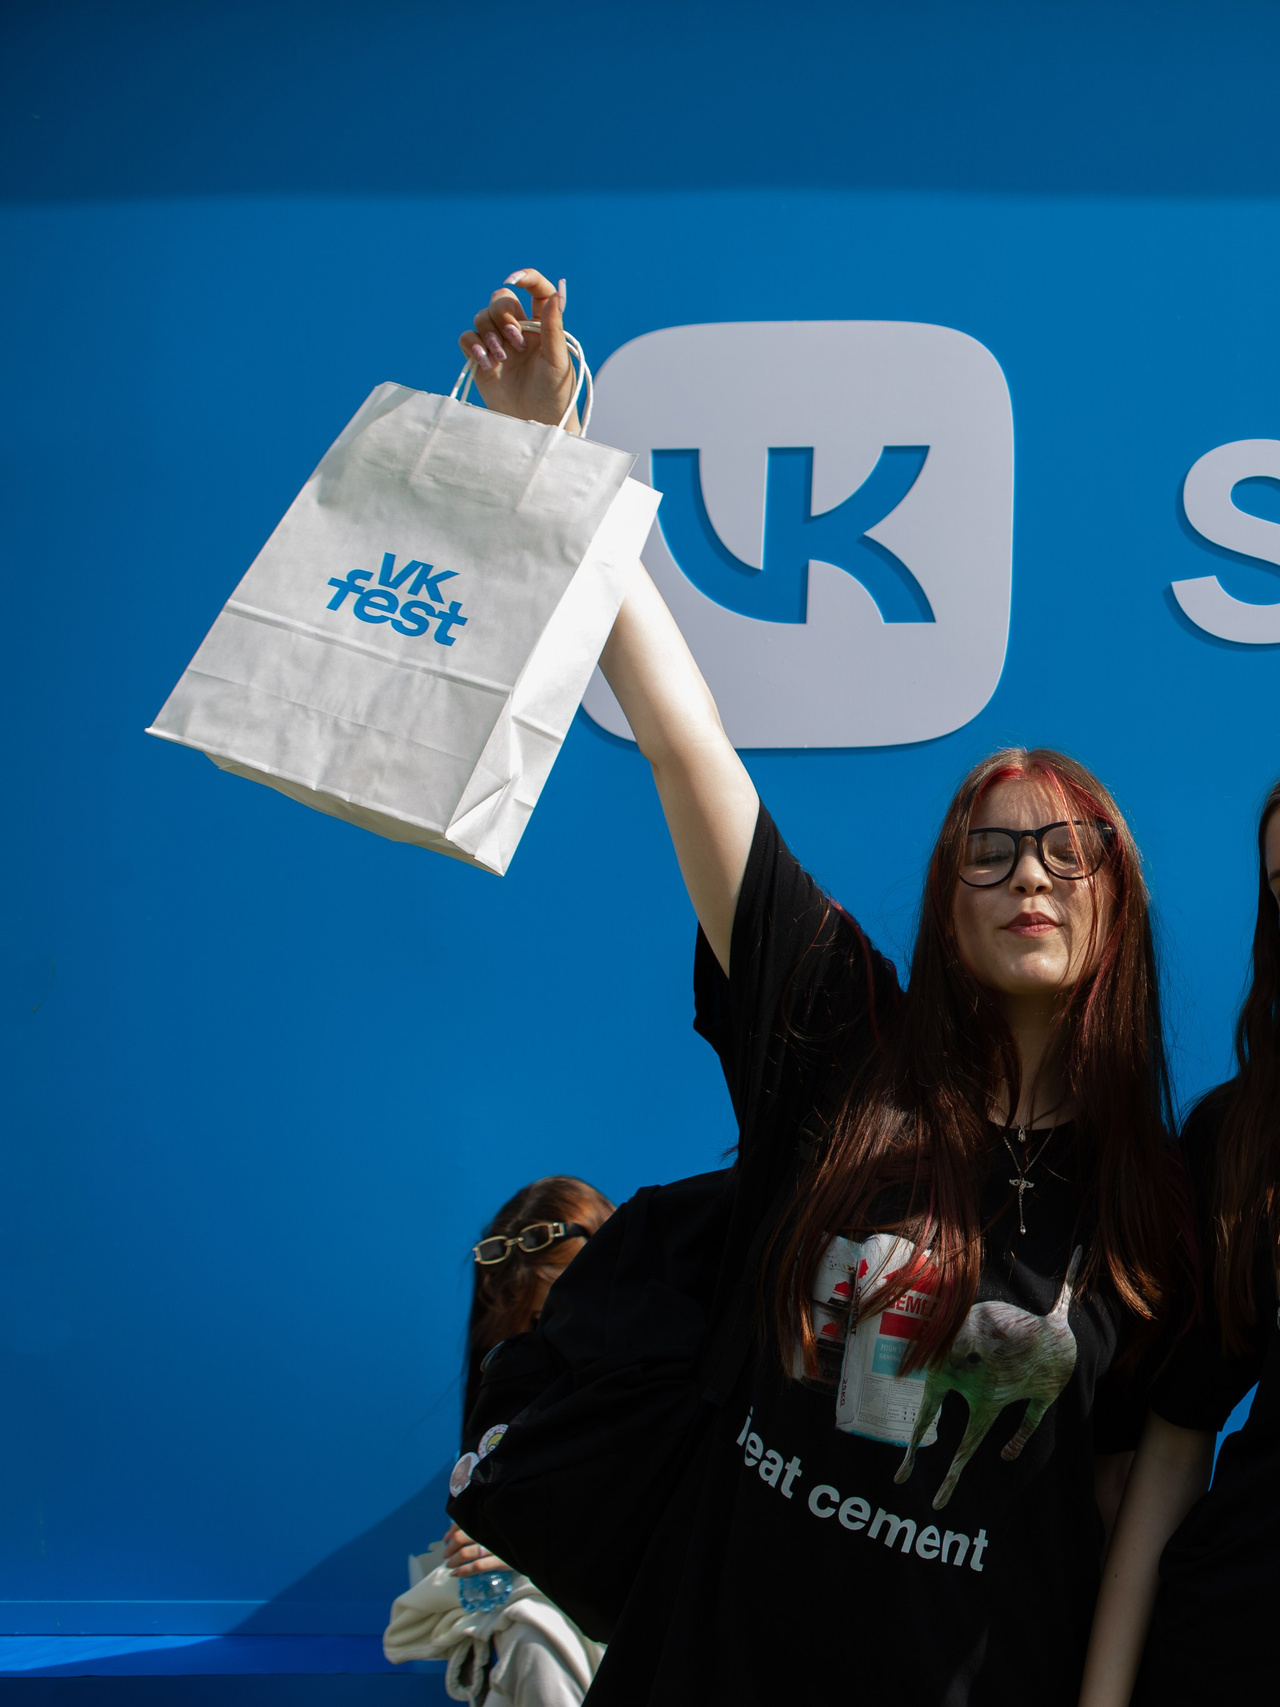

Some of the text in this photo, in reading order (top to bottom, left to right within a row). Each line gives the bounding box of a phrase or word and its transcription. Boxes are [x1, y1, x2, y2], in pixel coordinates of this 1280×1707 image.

[650, 444, 937, 624] VK
[326, 569, 468, 646] fest
[378, 552, 460, 605] VK
[840, 1379, 848, 1407] 25KG
[736, 1405, 989, 1572] i eat cement
